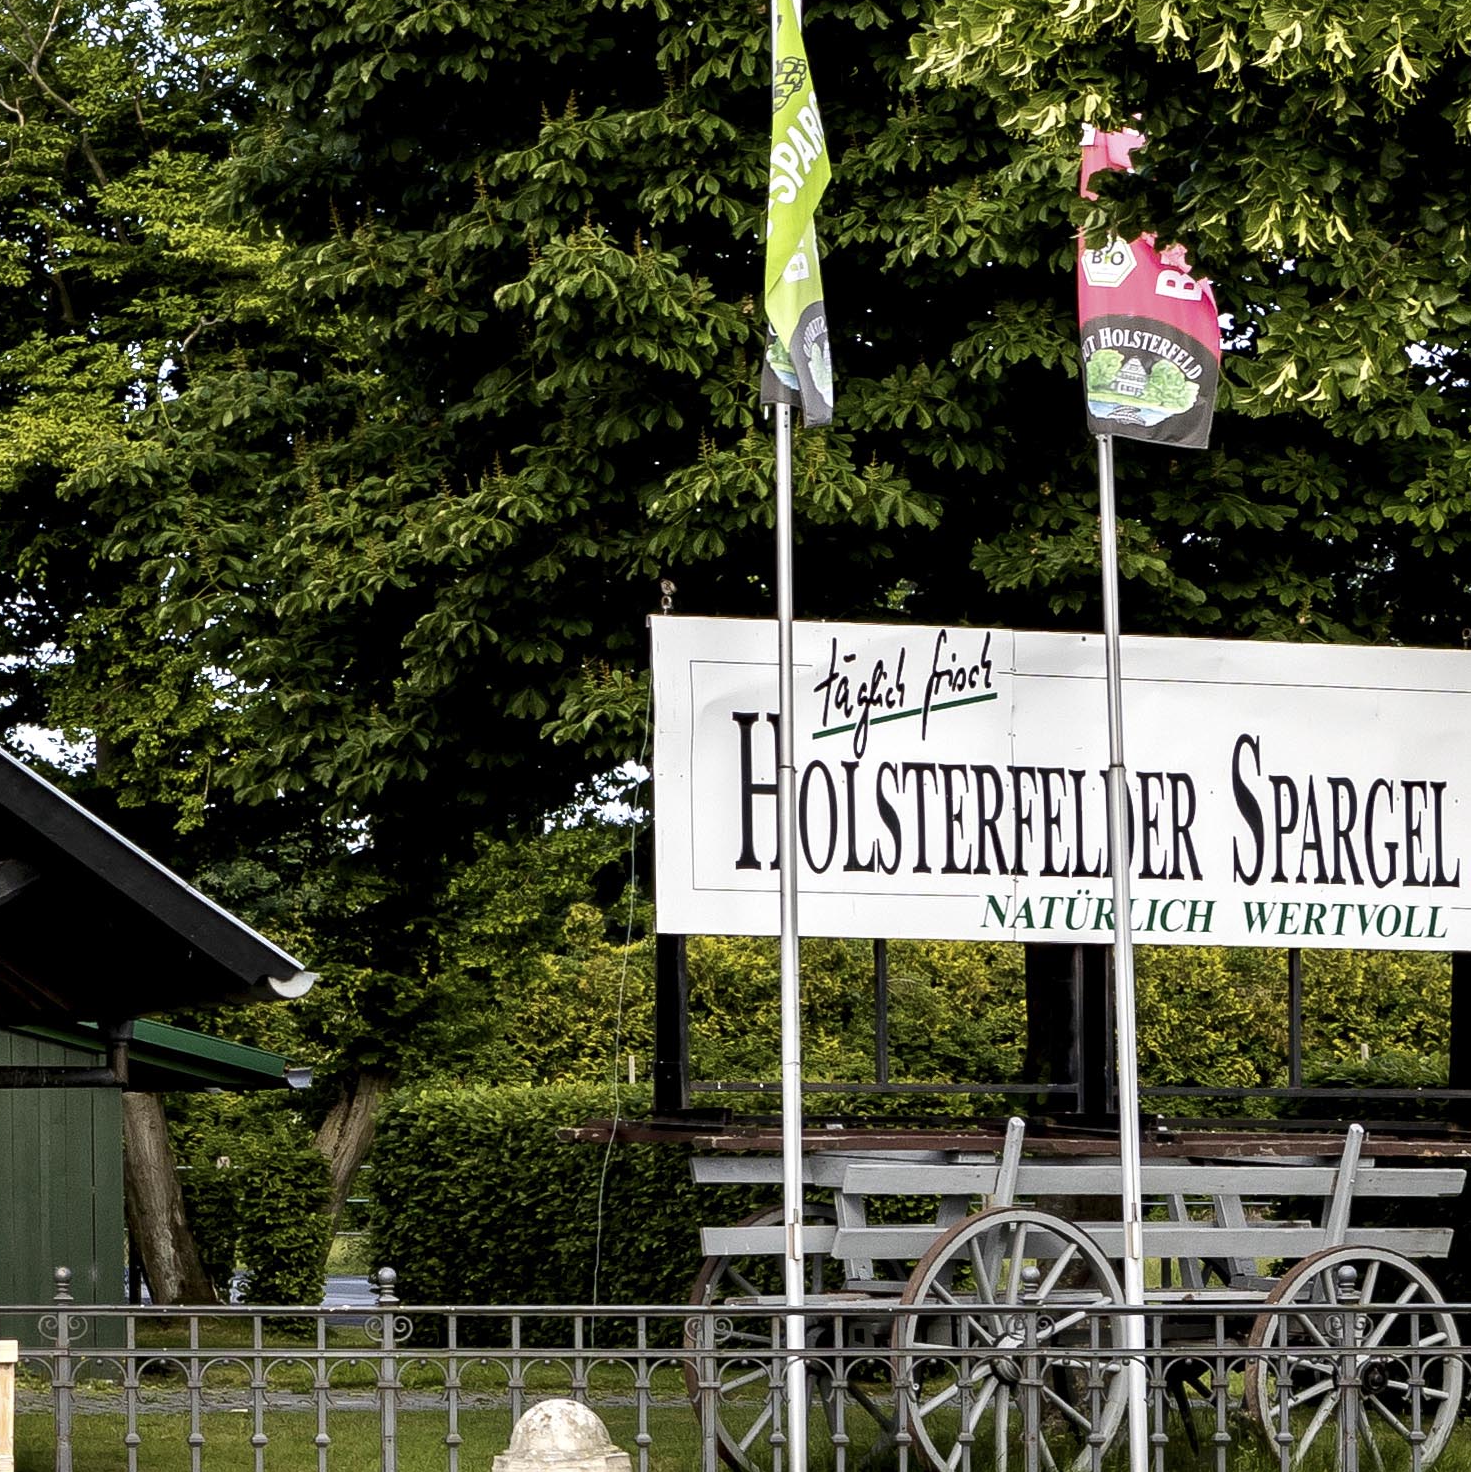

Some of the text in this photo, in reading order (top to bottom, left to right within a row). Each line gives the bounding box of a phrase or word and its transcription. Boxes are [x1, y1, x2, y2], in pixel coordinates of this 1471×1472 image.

[1098, 327, 1203, 380] HOLSTERFELD
[814, 628, 993, 759] täglich frisch
[1231, 733, 1460, 890] SPARGEL
[1243, 901, 1449, 939] WERTVOLL
